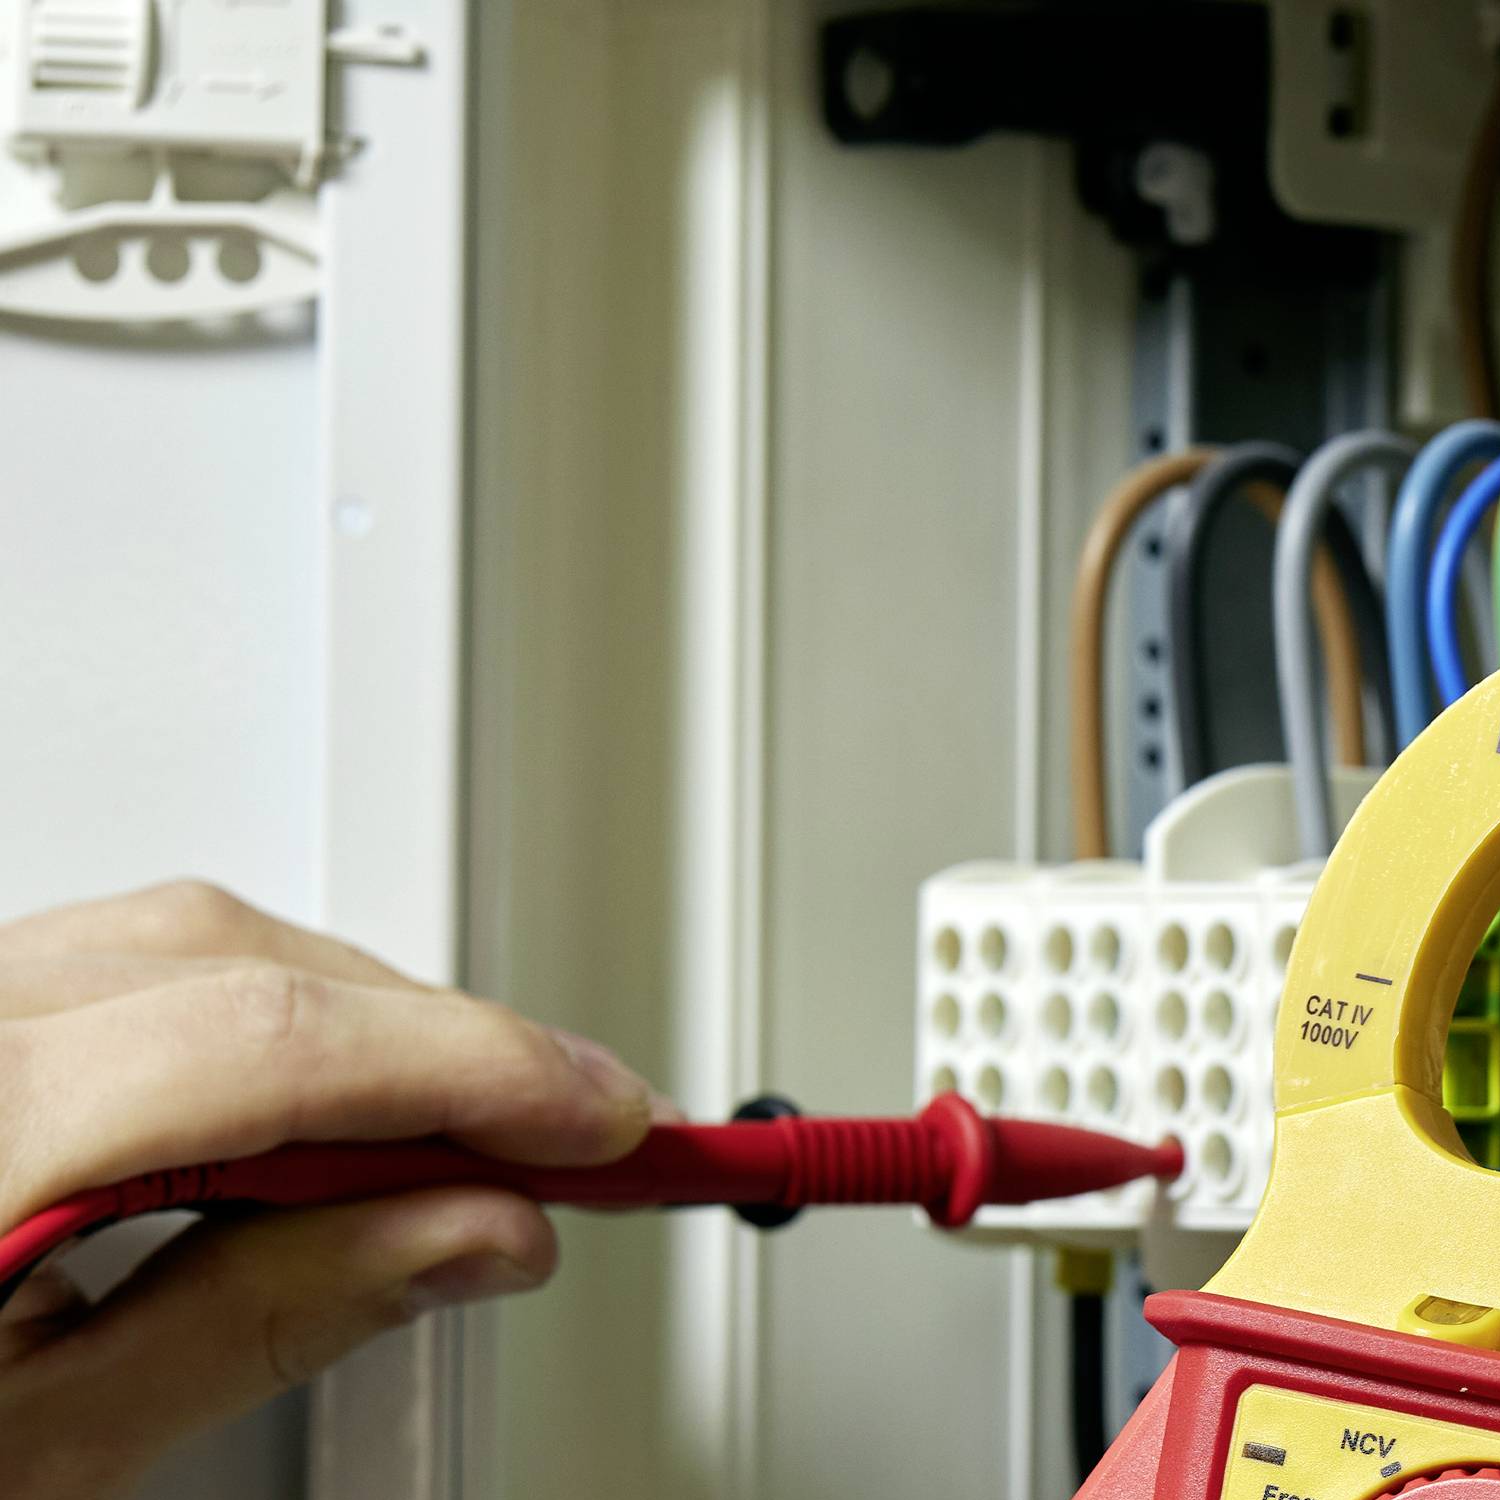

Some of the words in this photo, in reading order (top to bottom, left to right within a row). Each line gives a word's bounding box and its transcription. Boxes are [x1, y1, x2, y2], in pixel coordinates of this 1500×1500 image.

[1306, 995, 1348, 1020] CAT
[1351, 1005, 1374, 1026] IV
[1301, 1020, 1359, 1050] 1000V
[1340, 1428, 1397, 1459] NCV
